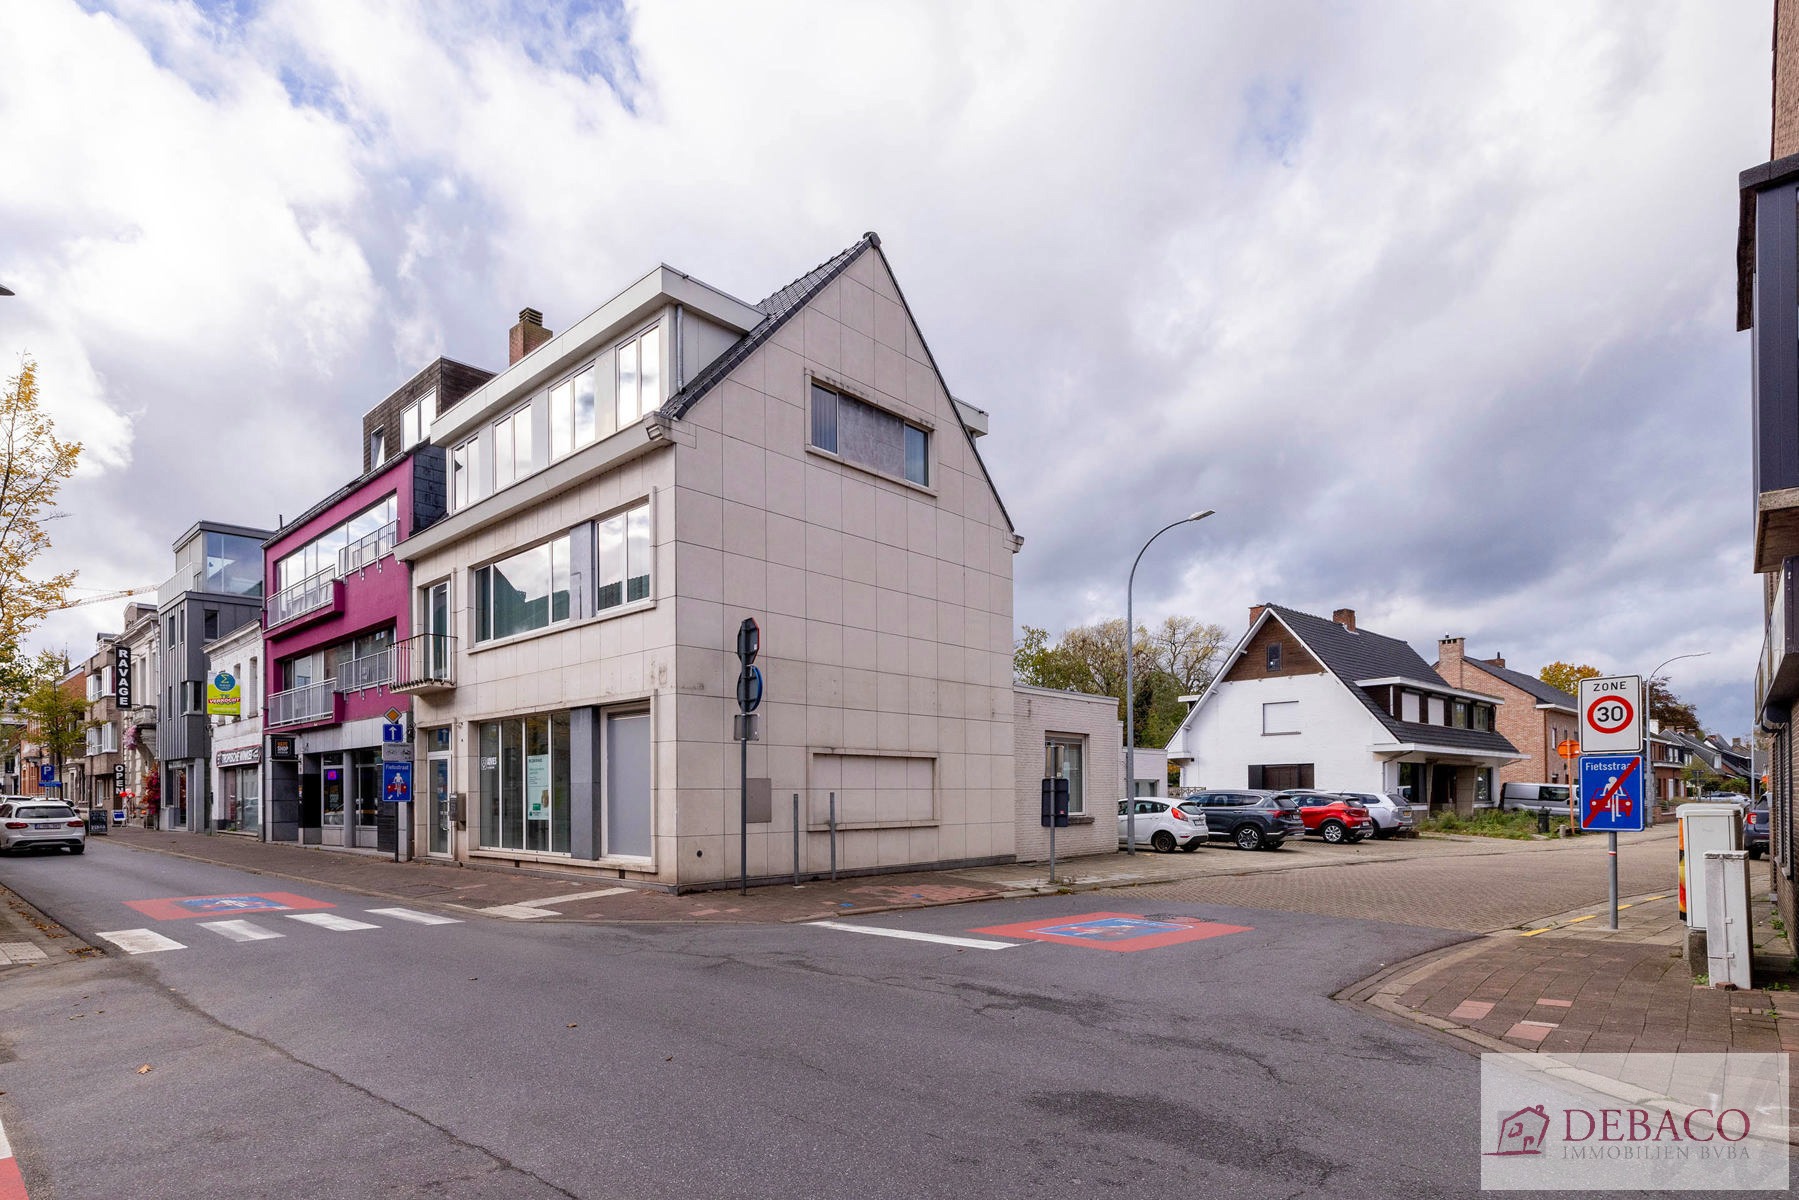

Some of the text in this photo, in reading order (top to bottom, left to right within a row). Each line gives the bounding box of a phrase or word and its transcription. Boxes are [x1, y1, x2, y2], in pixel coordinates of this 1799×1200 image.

[118, 649, 129, 706] RAVAGE
[1593, 681, 1627, 692] ZONE
[1597, 706, 1624, 722] 30
[43, 766, 52, 775] P
[115, 765, 124, 795] OPEN
